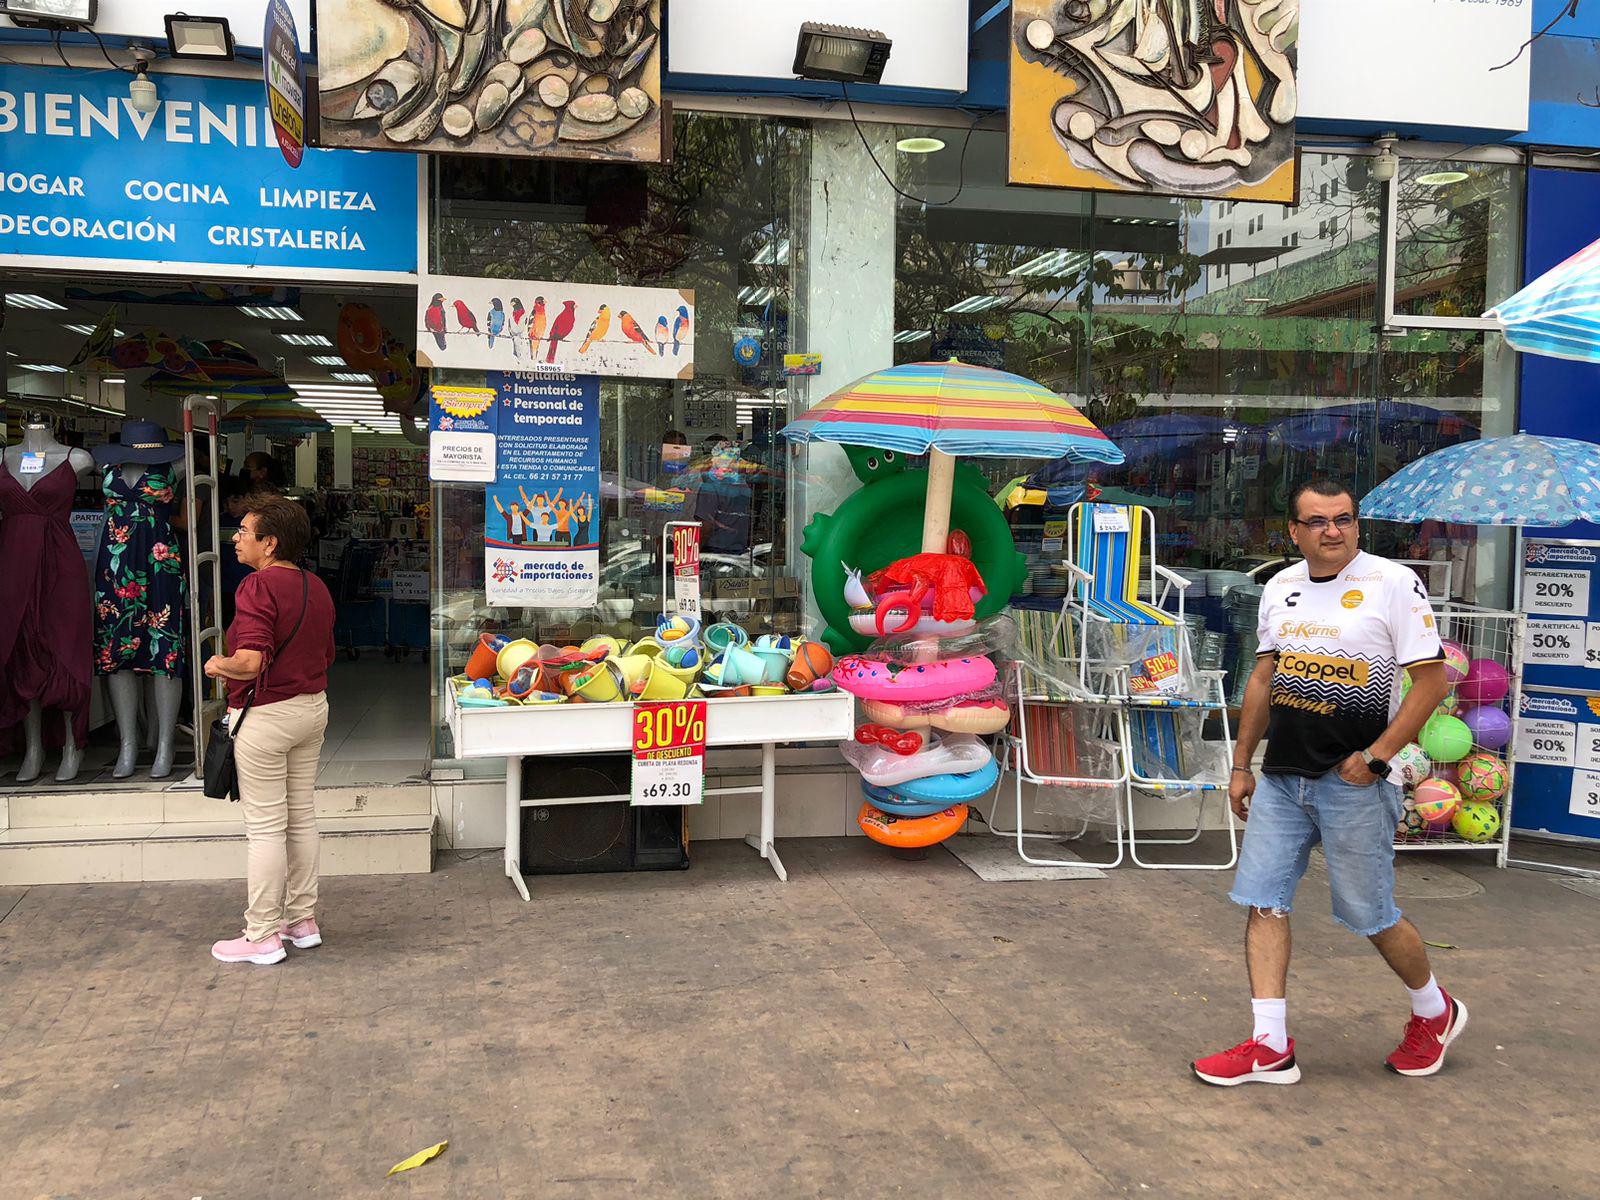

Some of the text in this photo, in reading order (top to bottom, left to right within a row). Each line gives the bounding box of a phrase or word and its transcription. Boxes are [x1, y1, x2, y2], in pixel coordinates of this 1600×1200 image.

[124, 179, 229, 205] COCINA
[259, 187, 376, 211] LIMPIEZA
[0, 214, 366, 251] DECORACIÓN CRISTALERÍA
[514, 383, 583, 396] Inventarios
[514, 398, 584, 411] Personal de
[514, 413, 583, 426] temporada
[543, 436, 590, 444] PRESENTARSE
[442, 445, 472, 453] PRECIOS
[529, 472, 539, 480] 66
[674, 527, 699, 566] 30%
[1547, 553, 1595, 561] importaciones
[524, 561, 585, 571] mercado de
[520, 569, 593, 581] importaciones
[1525, 571, 1586, 579] PORTARRETRATOS
[1535, 582, 1574, 598] 20%
[1278, 619, 1341, 640] SuKarne
[1542, 622, 1581, 630] ARTIFICAL
[1532, 633, 1571, 649] 50%
[1145, 654, 1177, 675] 50%
[1271, 685, 1338, 715] Caliente
[1531, 698, 1571, 707] mercado de
[1528, 703, 1576, 713] importaciones
[636, 703, 704, 750] 30%
[1525, 728, 1574, 737] SELECCIONADO
[1533, 738, 1566, 752] 60%
[647, 747, 693, 760] DE DESCUENTO
[1530, 754, 1568, 762] DESCUENTO
[643, 782, 691, 798] $69.30
